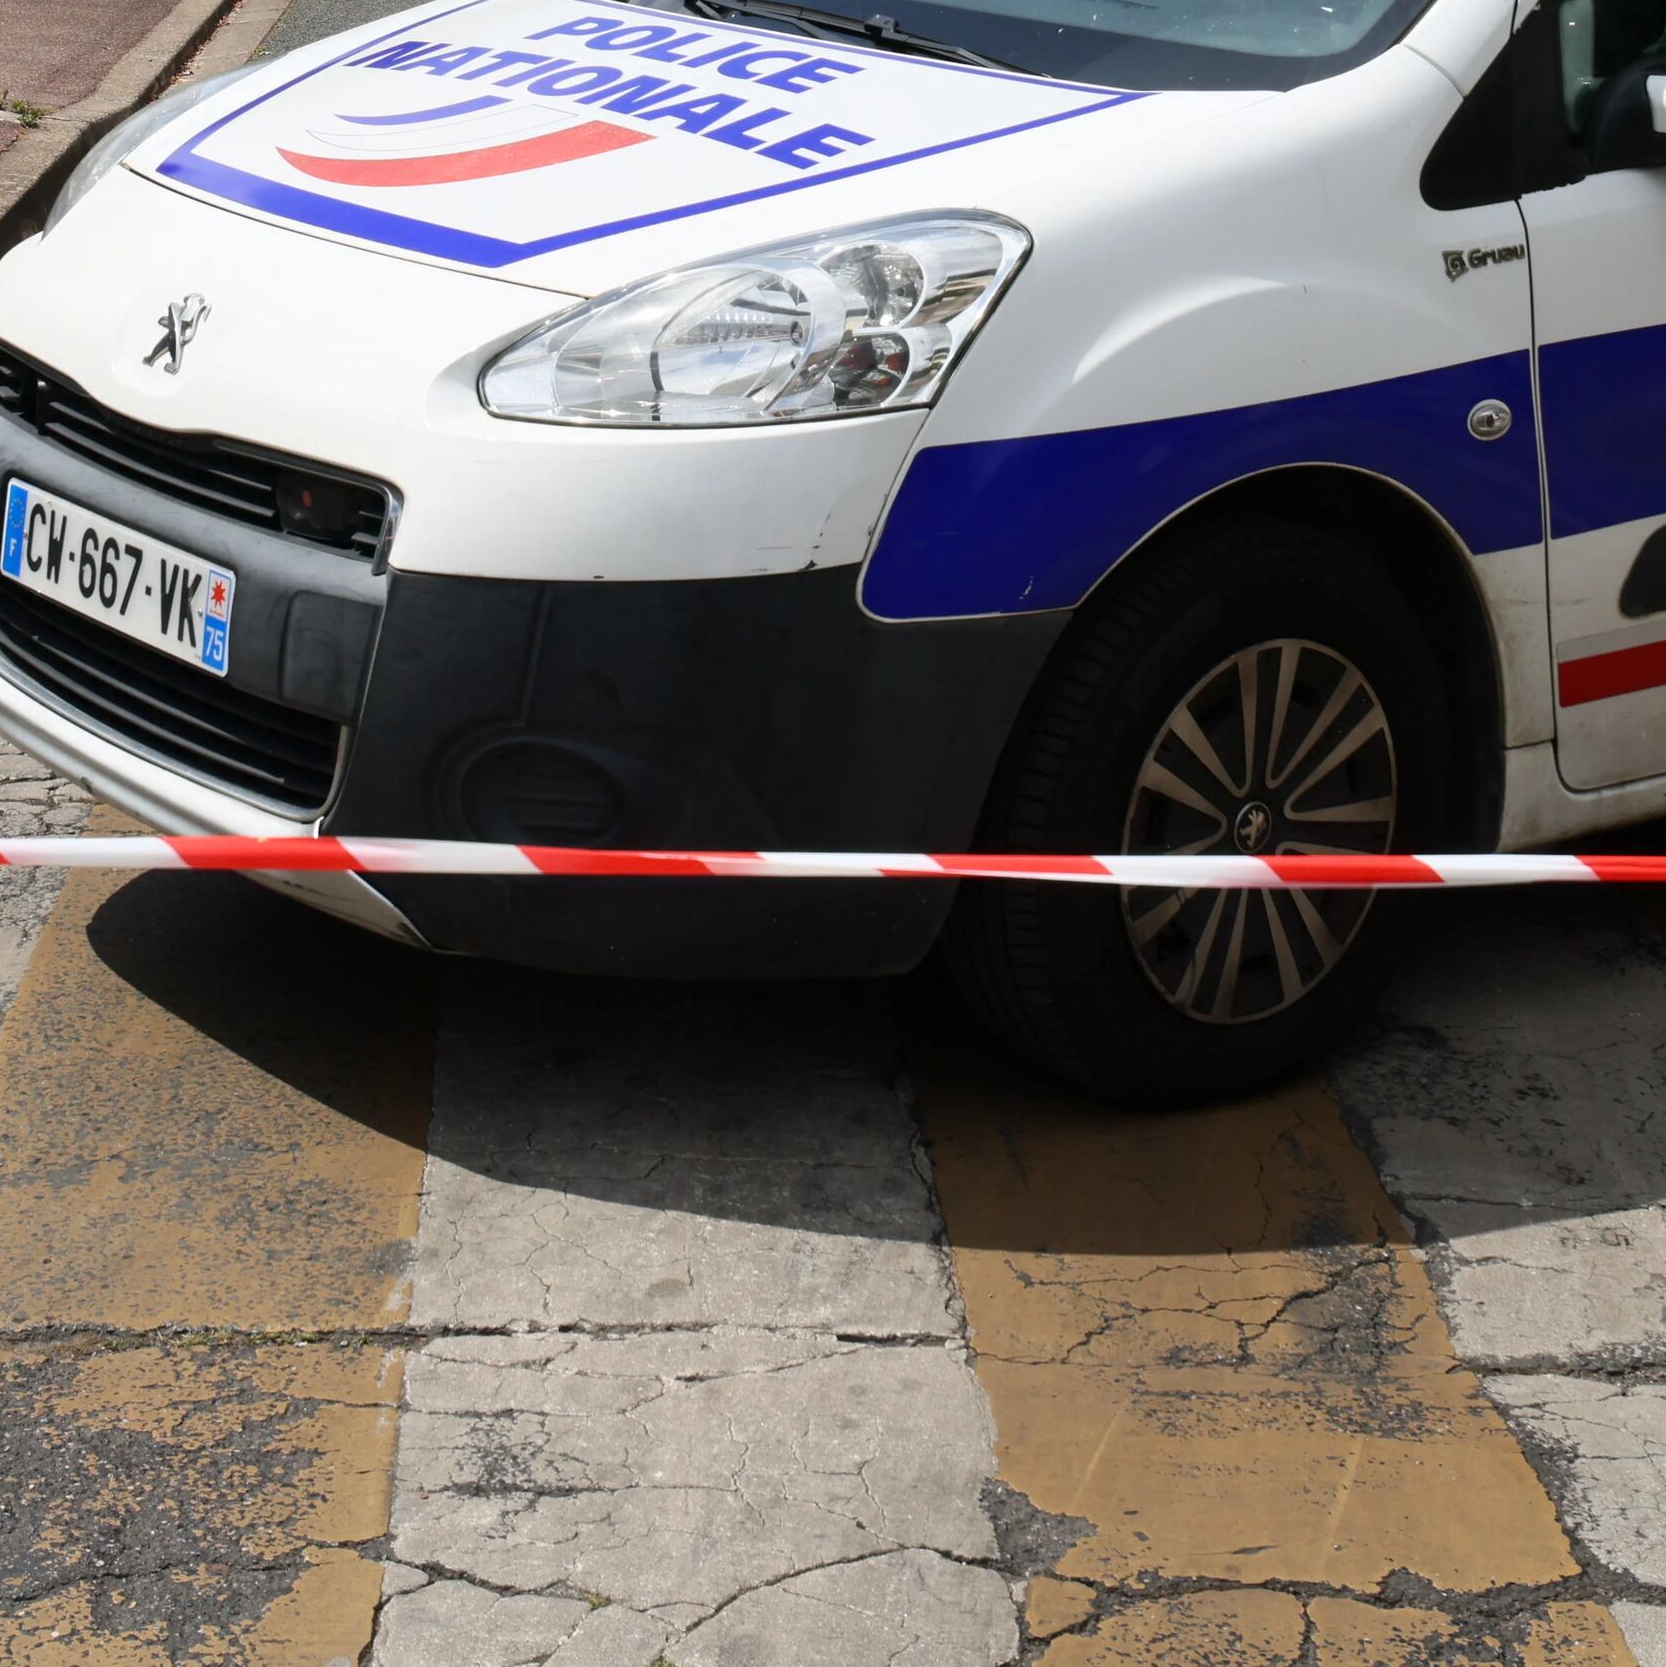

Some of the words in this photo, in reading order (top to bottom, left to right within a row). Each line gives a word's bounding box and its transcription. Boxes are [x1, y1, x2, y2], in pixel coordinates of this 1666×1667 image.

[523, 16, 866, 94] POLICE
[344, 40, 877, 170] NATIONALE
[1467, 243, 1525, 269] Gruau
[9, 538, 17, 557] F
[26, 503, 203, 648] CW-667-VK
[204, 625, 225, 661] 75
